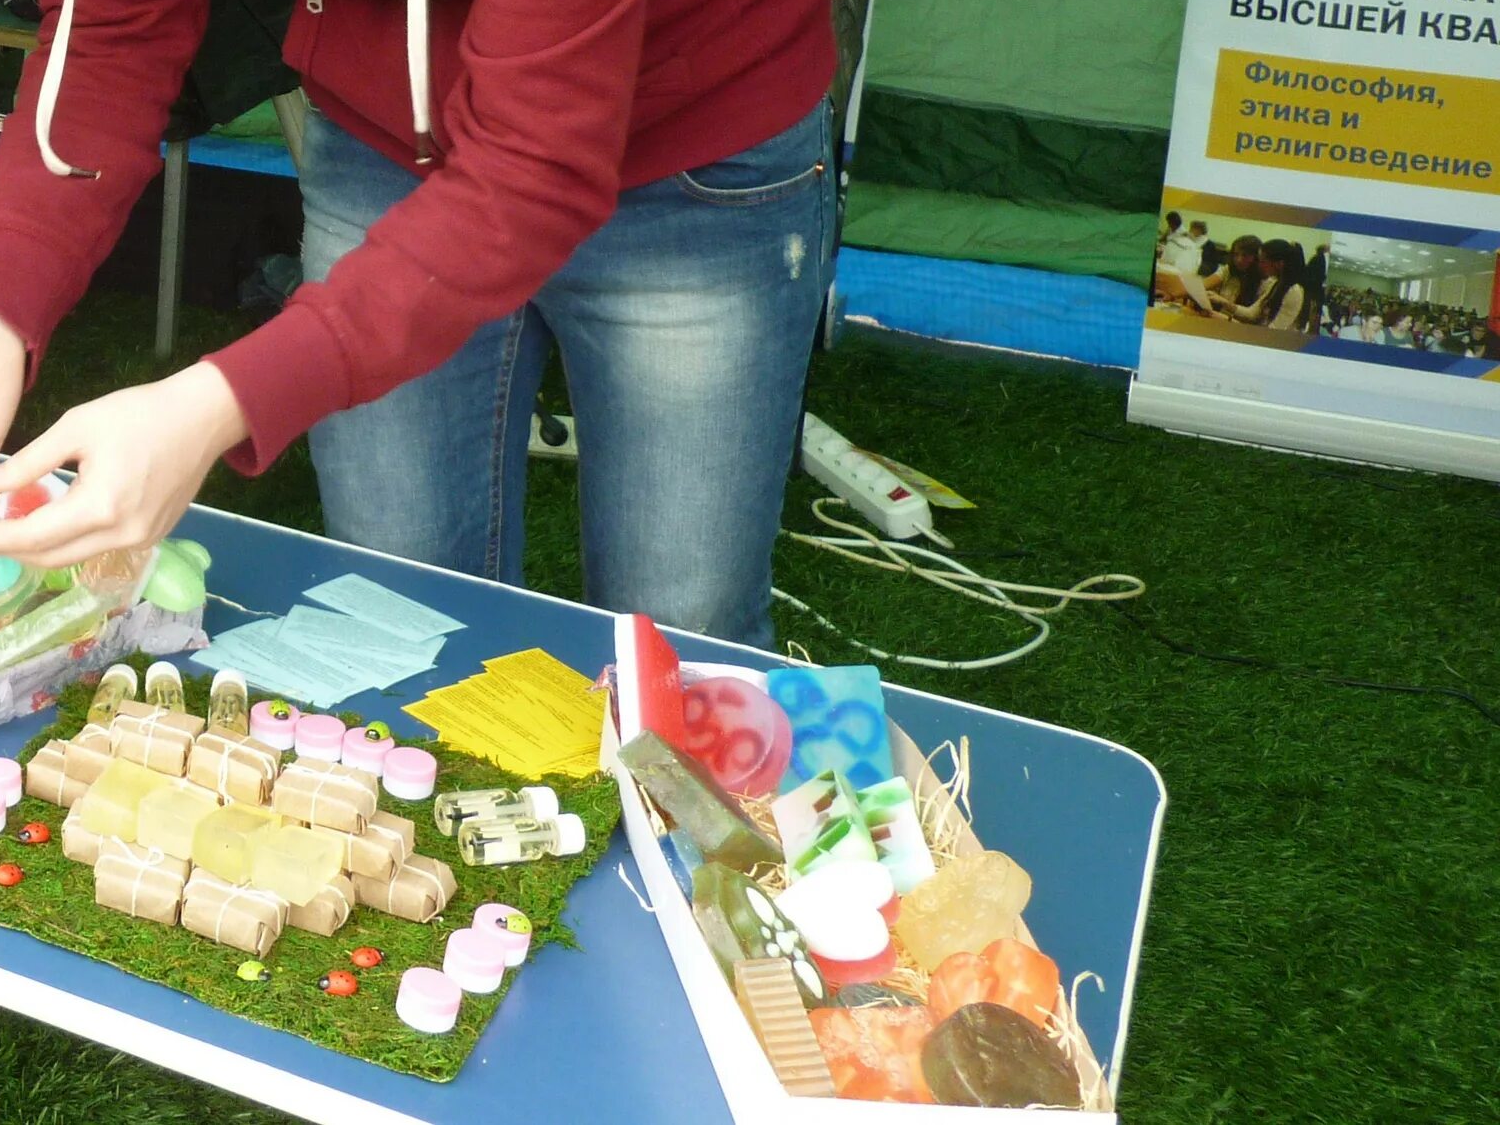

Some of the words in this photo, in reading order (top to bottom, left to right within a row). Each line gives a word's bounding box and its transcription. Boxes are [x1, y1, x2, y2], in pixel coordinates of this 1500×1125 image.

[1418, 12, 1500, 44] КВА
[1245, 61, 1445, 109] Философия,
[1239, 98, 1330, 127] этика
[1341, 111, 1360, 129] и
[1235, 131, 1493, 179] религоведение
